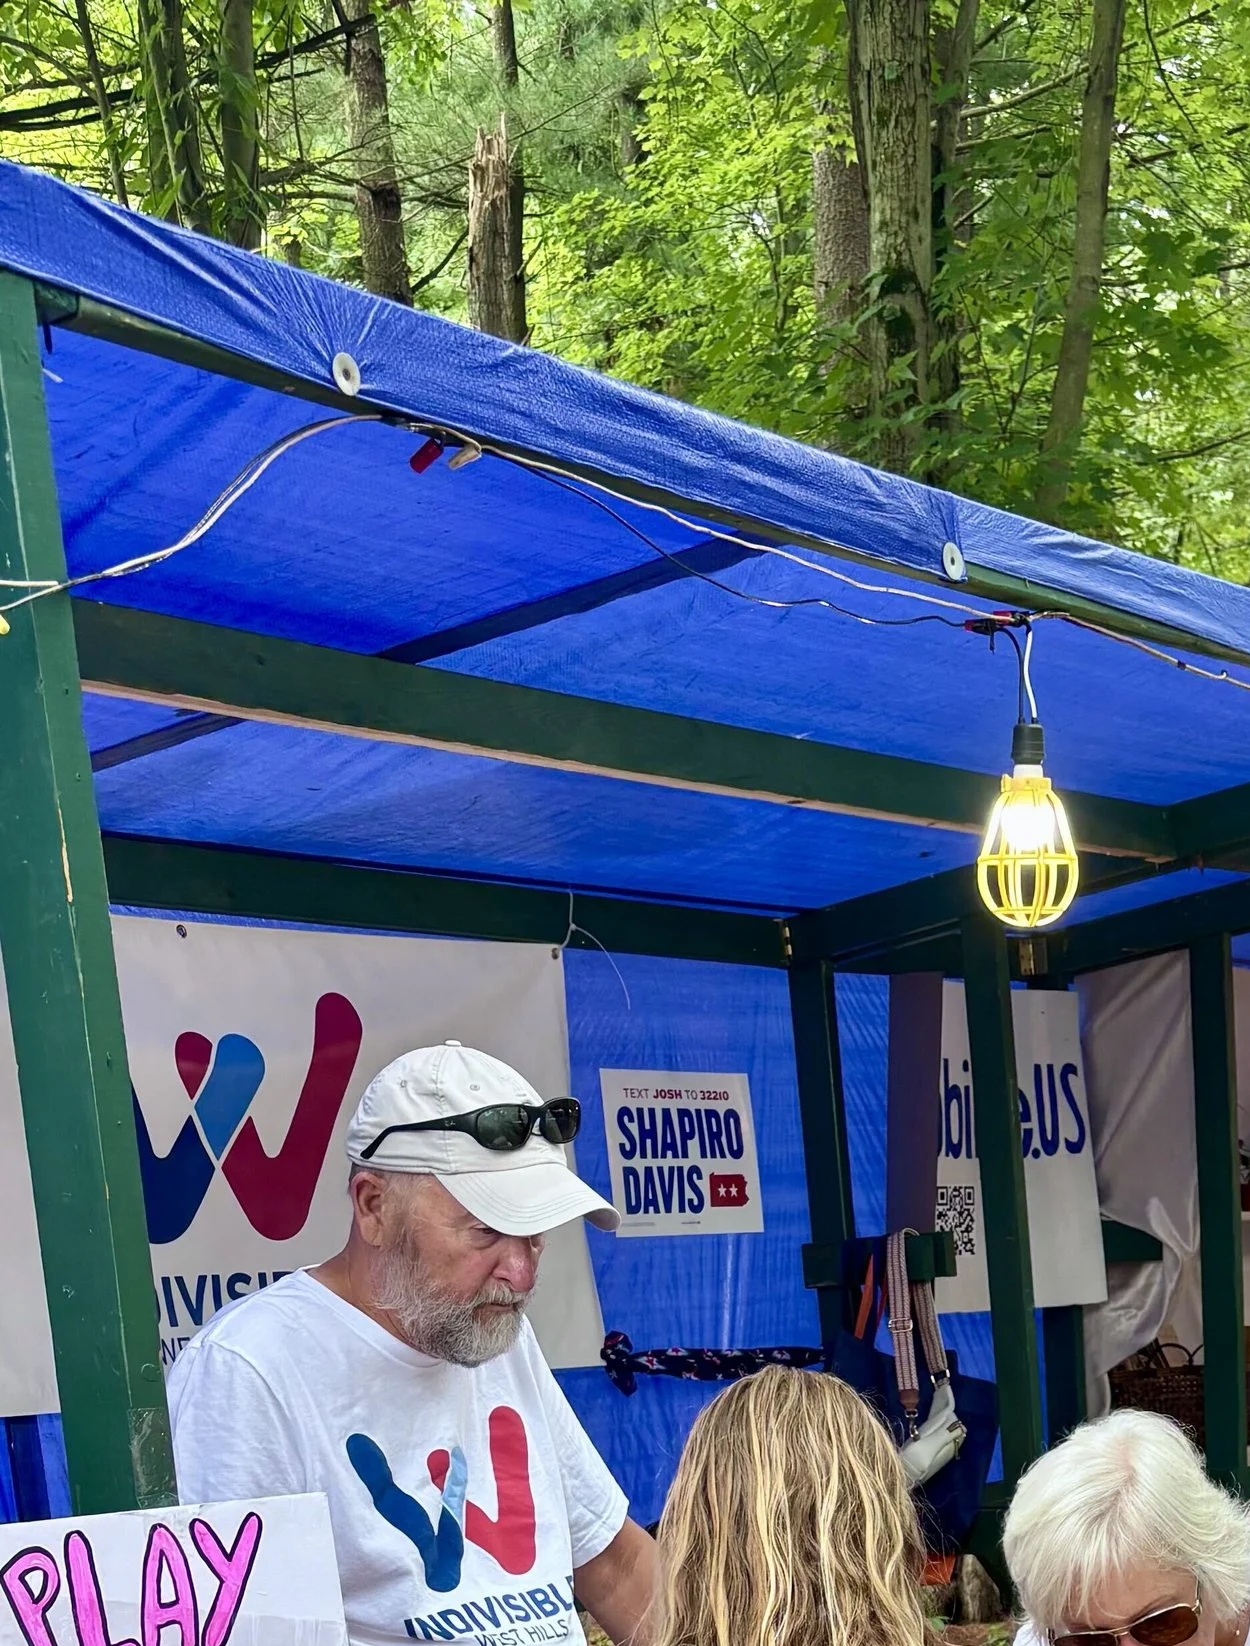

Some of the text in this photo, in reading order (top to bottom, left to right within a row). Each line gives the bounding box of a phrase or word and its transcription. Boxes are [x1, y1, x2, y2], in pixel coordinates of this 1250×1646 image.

[623, 1088, 729, 1101] TEXT JOSH TO 32210
[617, 1106, 744, 1160] SHAPIRO
[622, 1164, 705, 1215] DAVIS
[524, 1619, 569, 1643] HILLS
